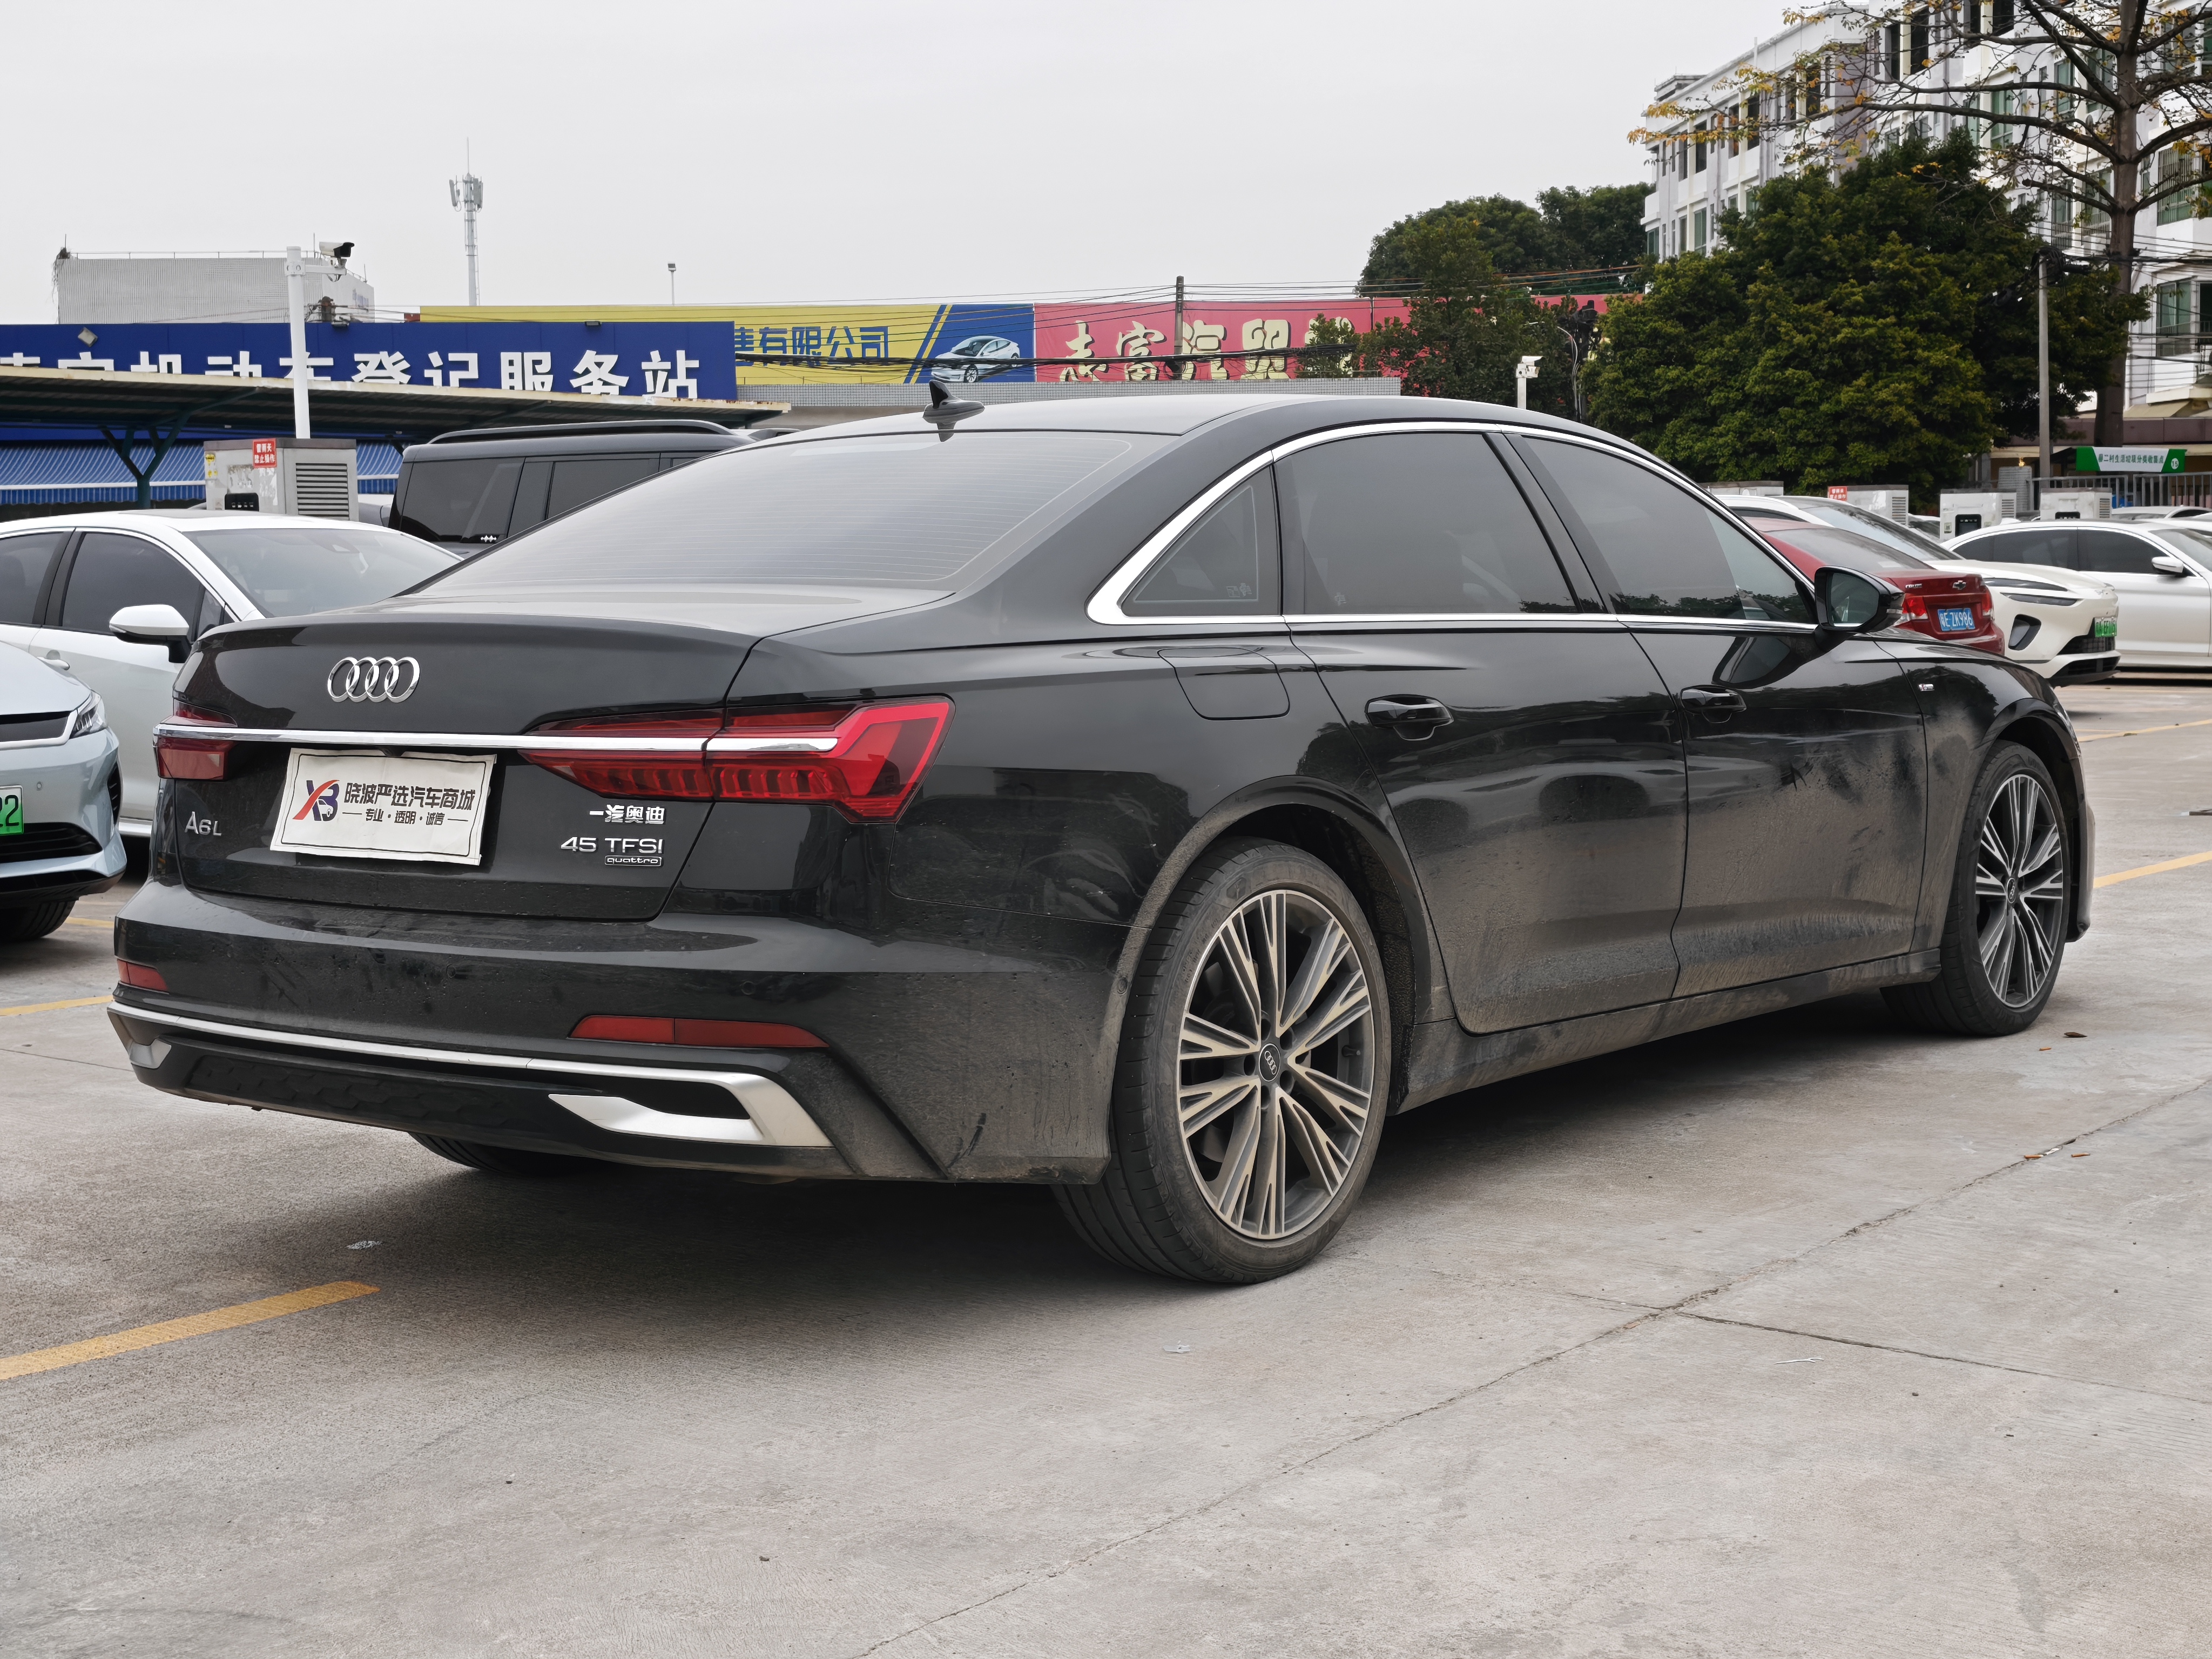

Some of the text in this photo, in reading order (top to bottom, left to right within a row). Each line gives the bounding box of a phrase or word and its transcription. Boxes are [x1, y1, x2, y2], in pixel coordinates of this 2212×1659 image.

[343, 782, 476, 811] 晓波严选汽车商城
[0, 794, 19, 827] 2
[589, 804, 665, 825] 一汽奥迪
[184, 811, 222, 836] A6L
[560, 837, 663, 854] 45 TFSI
